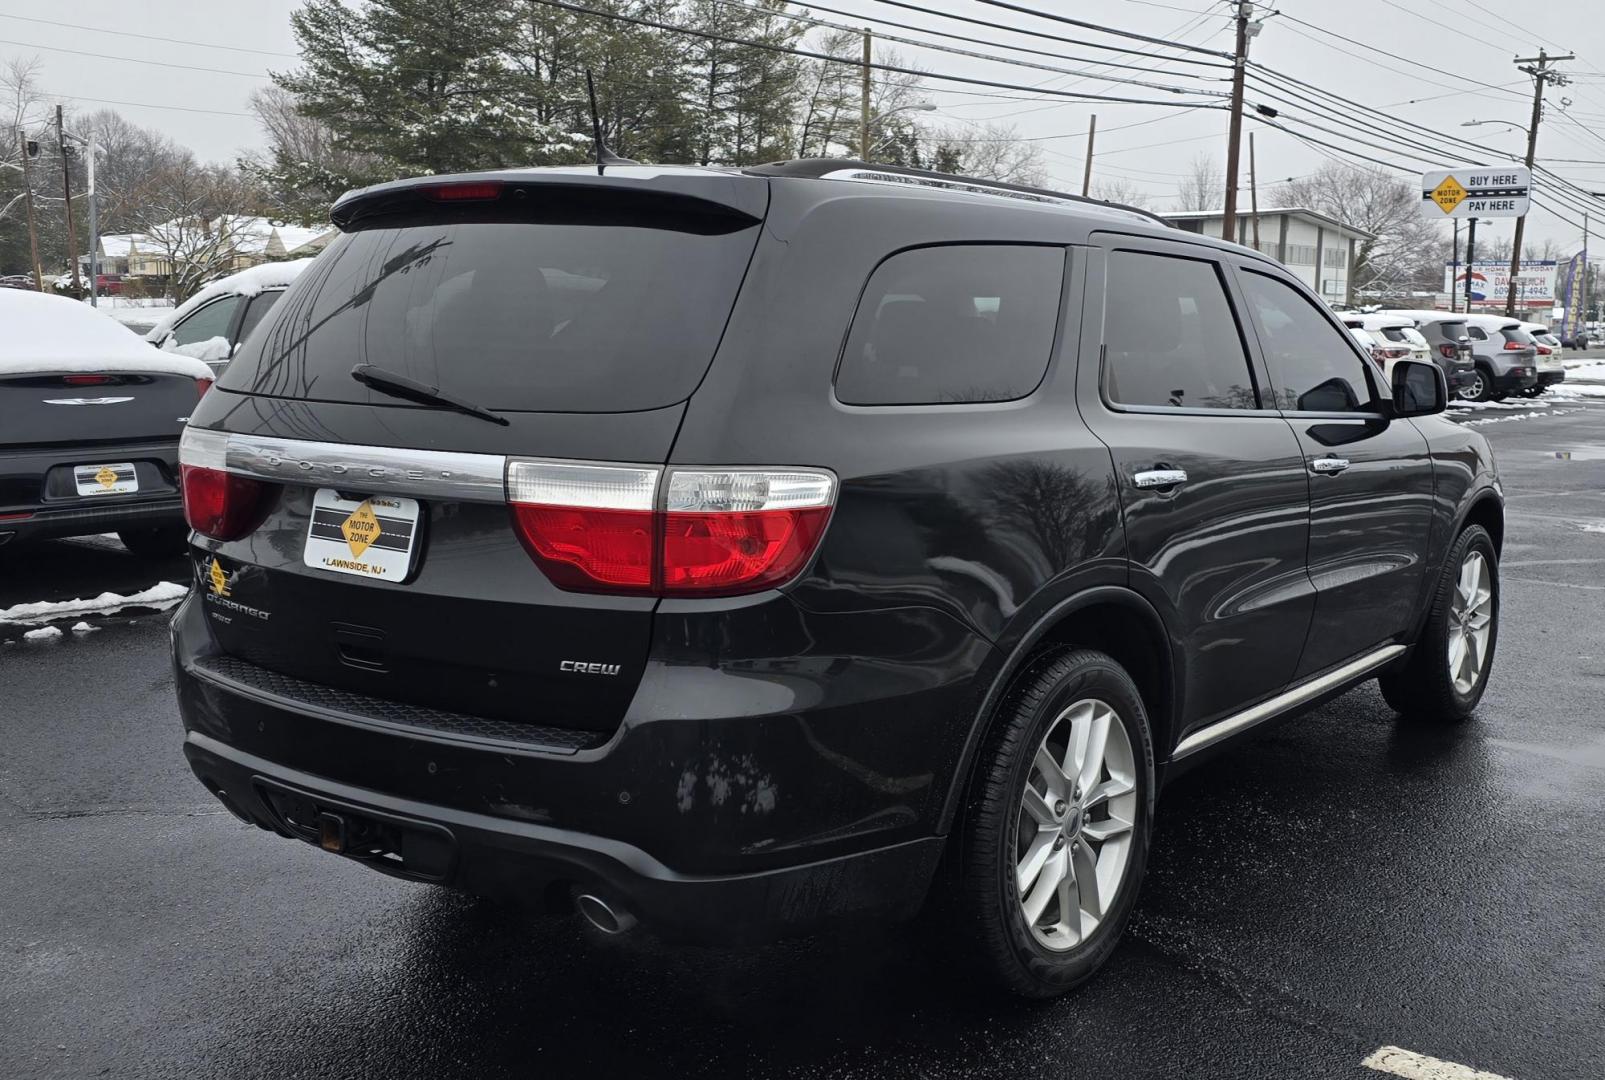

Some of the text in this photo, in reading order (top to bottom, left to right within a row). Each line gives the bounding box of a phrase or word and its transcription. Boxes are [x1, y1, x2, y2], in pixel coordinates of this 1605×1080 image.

[1470, 174, 1518, 186] BUY HERE
[1437, 189, 1461, 197] MOTOR
[1468, 200, 1515, 211] PAY HERE
[268, 456, 424, 480] DODGE
[348, 519, 375, 533] MOTOR
[349, 532, 370, 544] ZONE
[325, 557, 382, 575] LAWNSIDE, NJ
[206, 593, 272, 621] DURANGO
[559, 660, 622, 675] CREW
